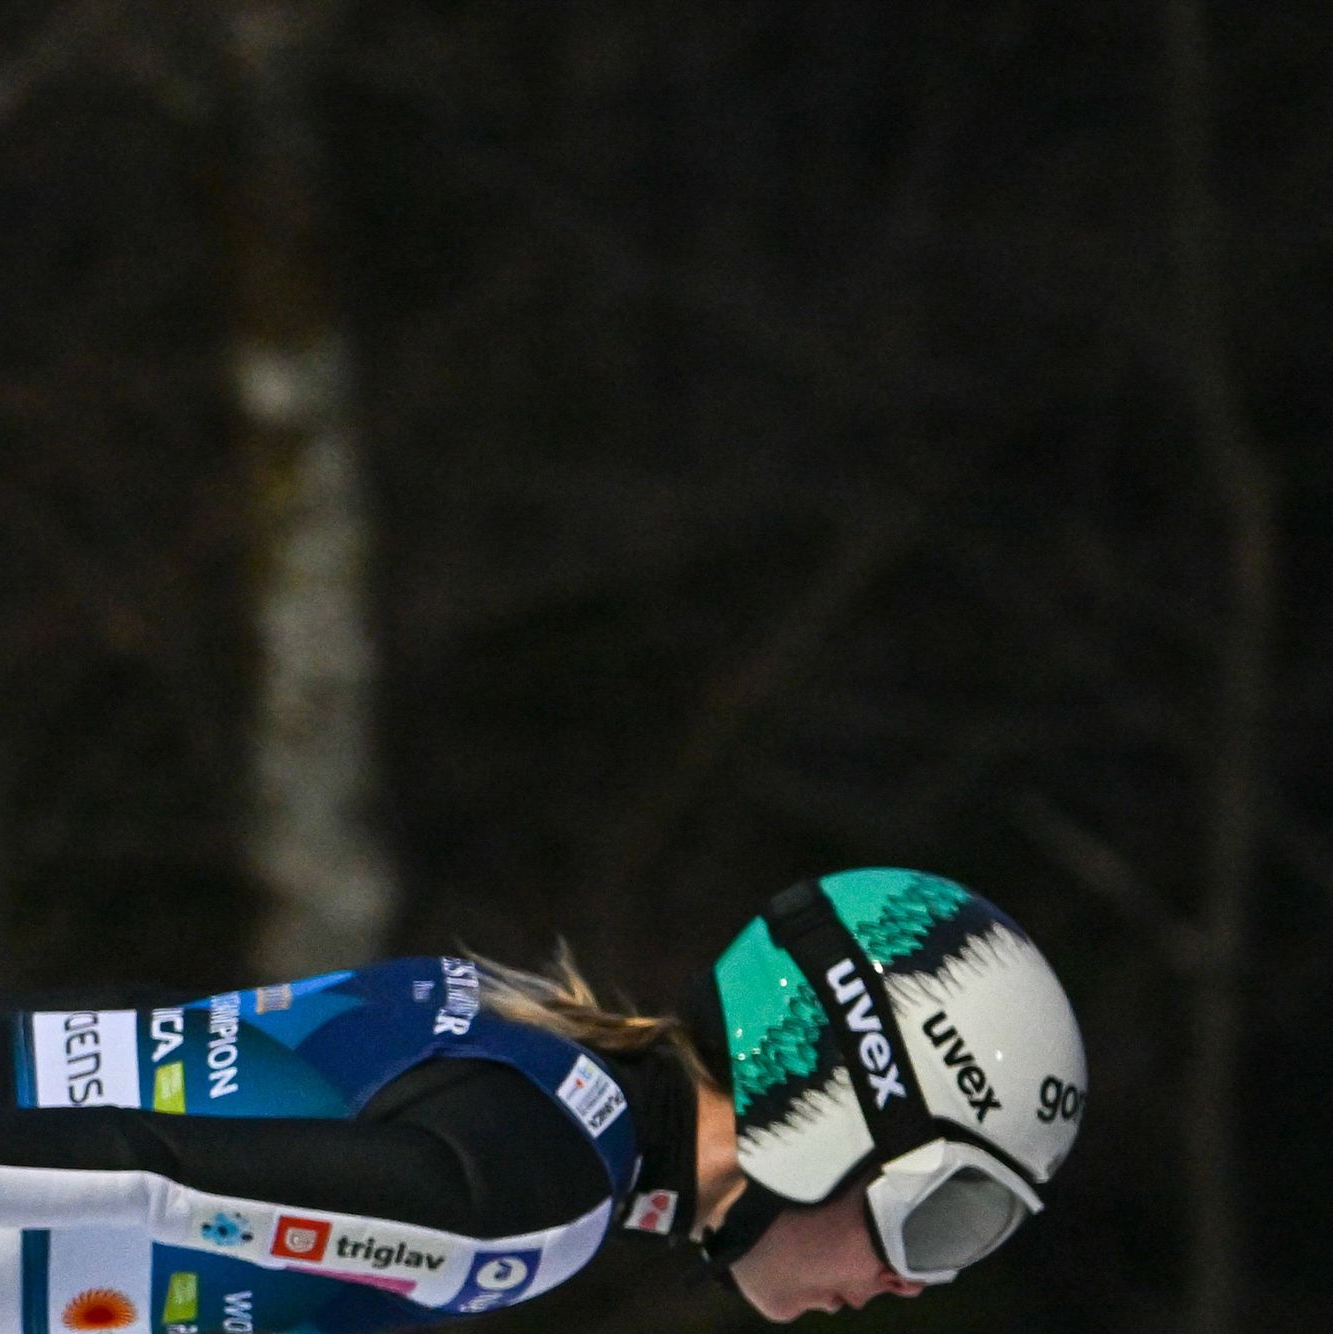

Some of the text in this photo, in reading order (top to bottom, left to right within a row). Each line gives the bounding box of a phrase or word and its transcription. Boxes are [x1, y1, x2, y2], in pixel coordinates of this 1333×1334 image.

[826, 957, 906, 1111] uvex
[922, 1011, 1001, 1122] uvex
[336, 1234, 445, 1271] triglav
